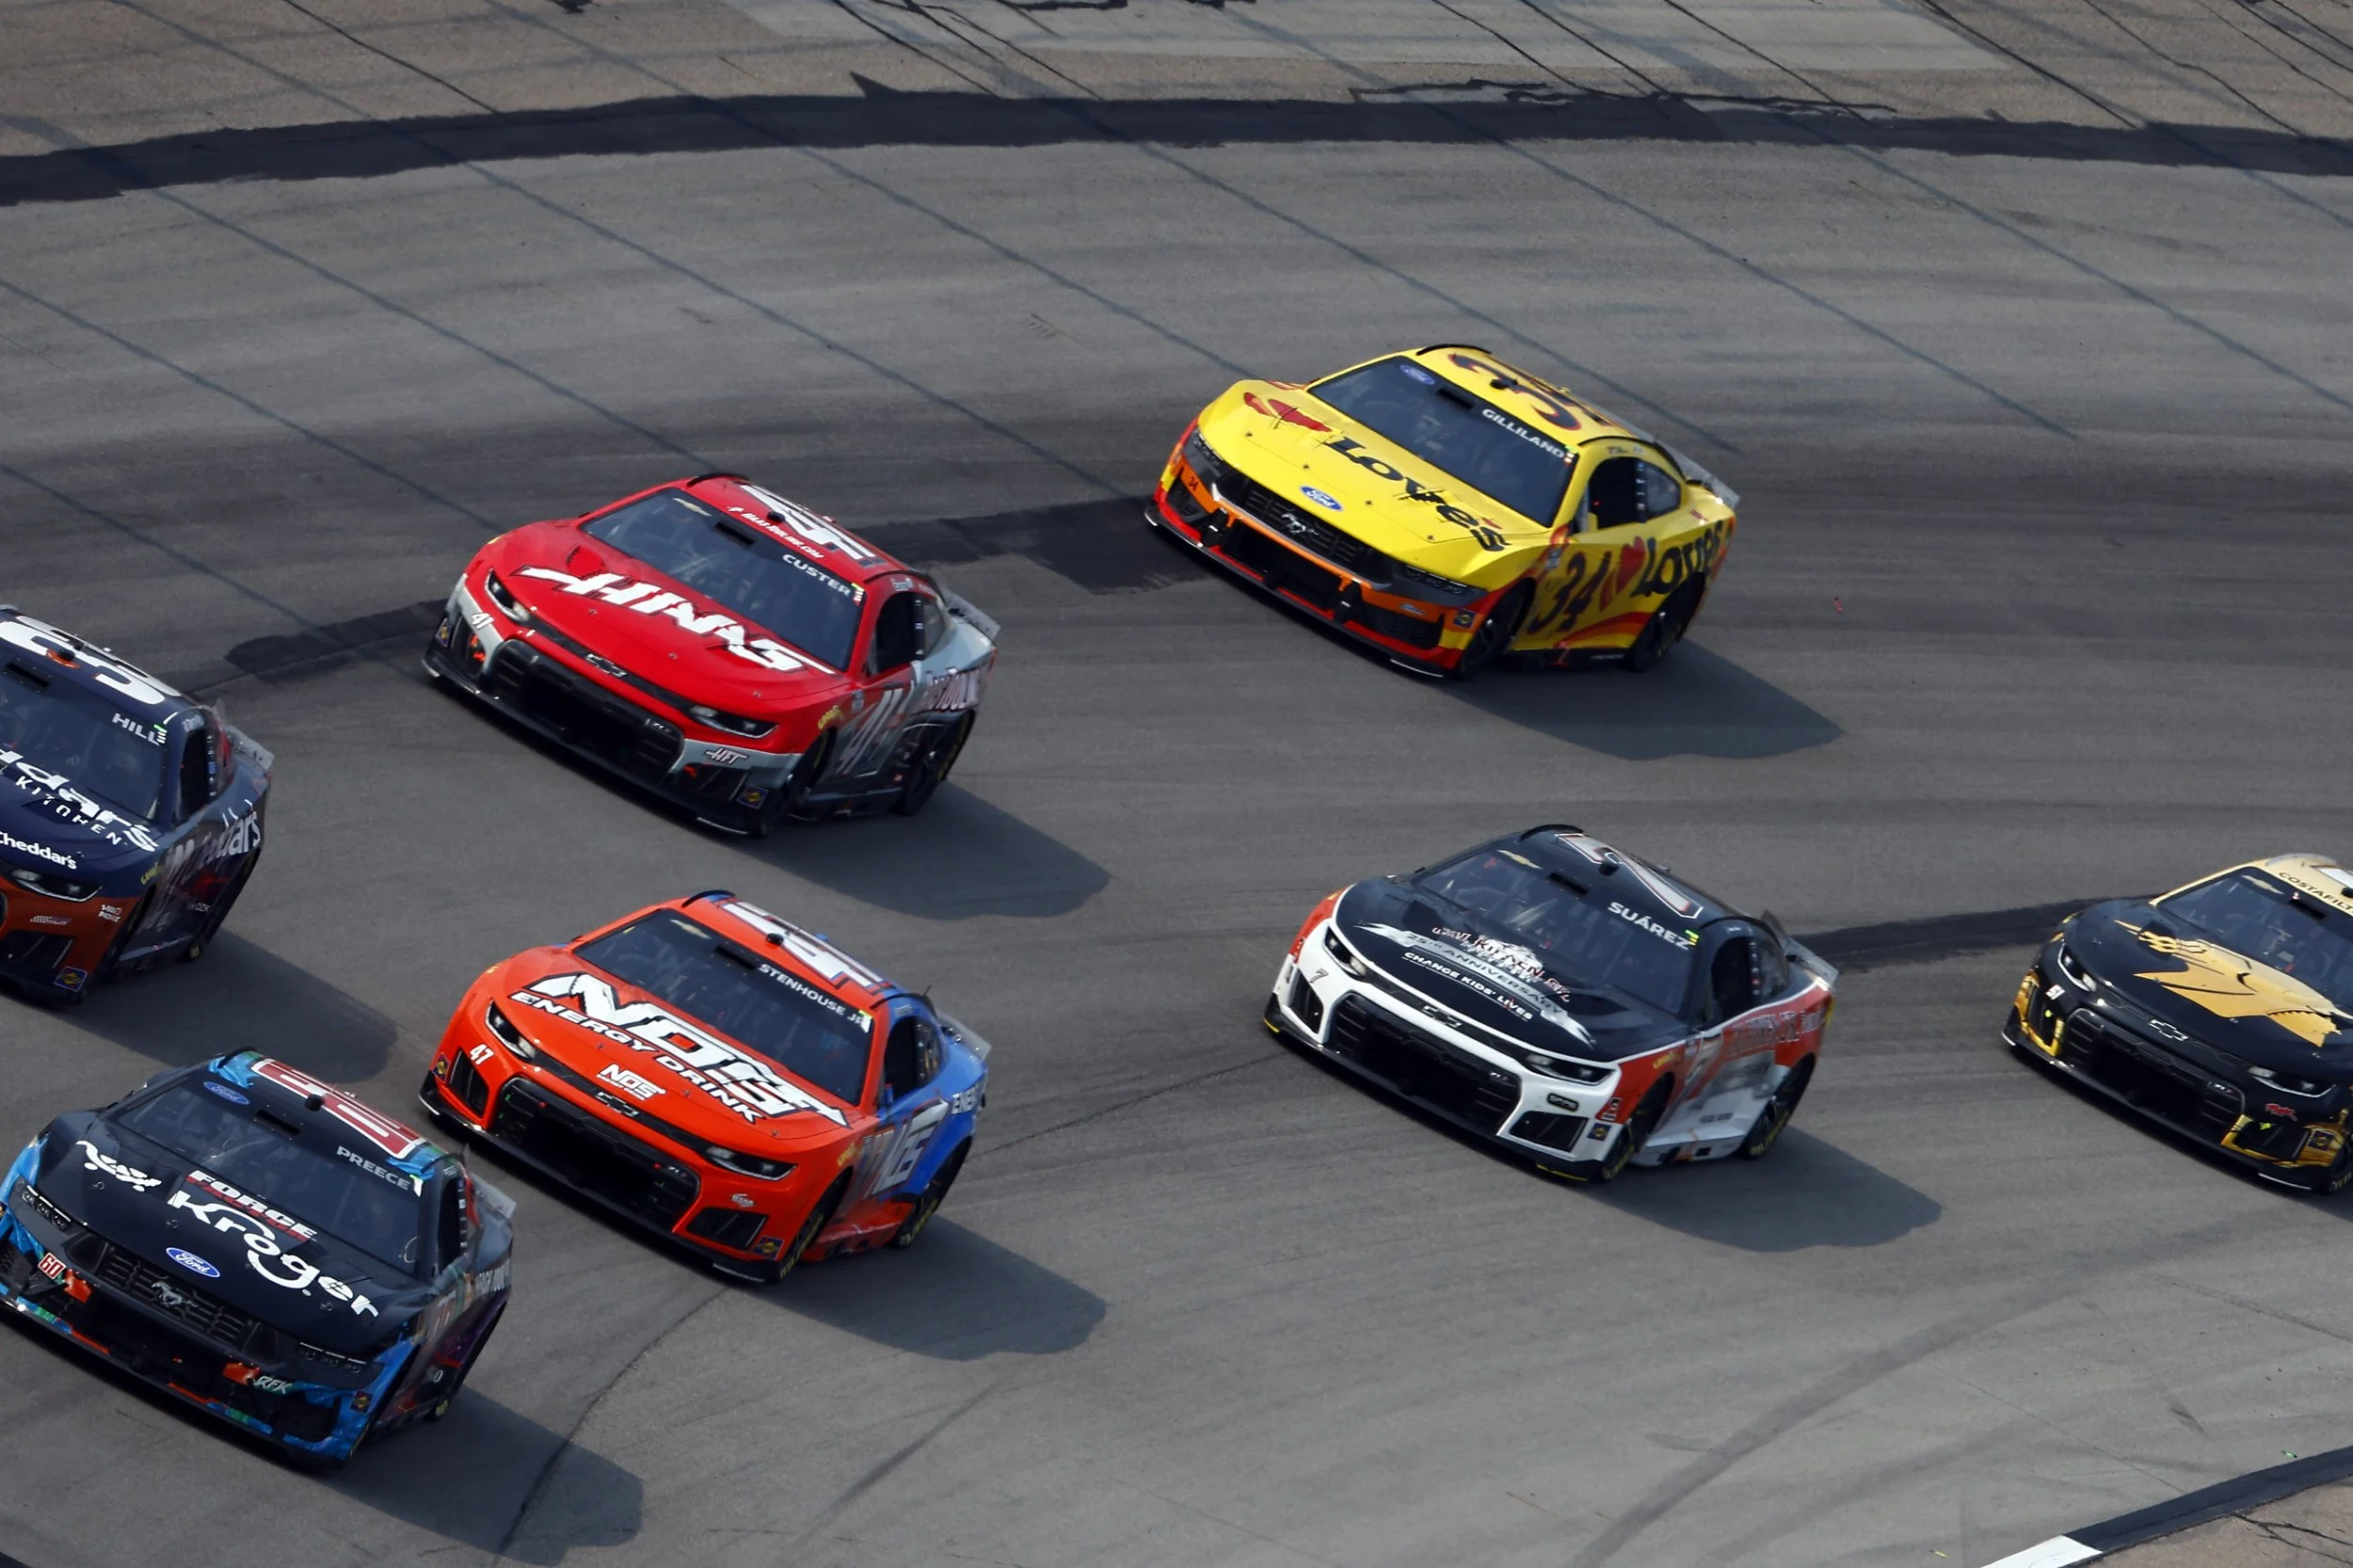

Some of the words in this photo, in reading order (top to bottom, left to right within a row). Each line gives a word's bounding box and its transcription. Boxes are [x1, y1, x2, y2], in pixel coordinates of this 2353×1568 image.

[1481, 408, 1564, 458] GILLILAND
[1304, 488, 1338, 508] Ford
[782, 553, 852, 597] CUSTER
[1527, 551, 1612, 633] 34
[472, 612, 495, 631] 41
[112, 712, 160, 746] HILL
[15, 776, 121, 845] KITCHEN
[2279, 872, 2353, 916] COSTAFILT
[1608, 901, 1690, 951] SUÁREZ
[759, 963, 847, 1016] STENHOUSE
[1309, 968, 1330, 984] 7
[1403, 952, 1461, 979] CHANGE
[1460, 975, 1497, 997] KIDS'
[1497, 995, 1534, 1020] LIVES
[1444, 949, 1565, 1015] ANNIVERSARY
[469, 1042, 495, 1066] 47
[508, 990, 660, 1053] ENERGY
[654, 1054, 766, 1125] DRINK
[599, 1063, 666, 1099] NOS
[336, 1145, 411, 1190] PREECE
[186, 1170, 318, 1240] FORCE
[38, 1251, 67, 1281] 60
[166, 1189, 379, 1319] Kroger
[171, 1250, 215, 1275] Ford
[253, 1375, 293, 1395] RFK
